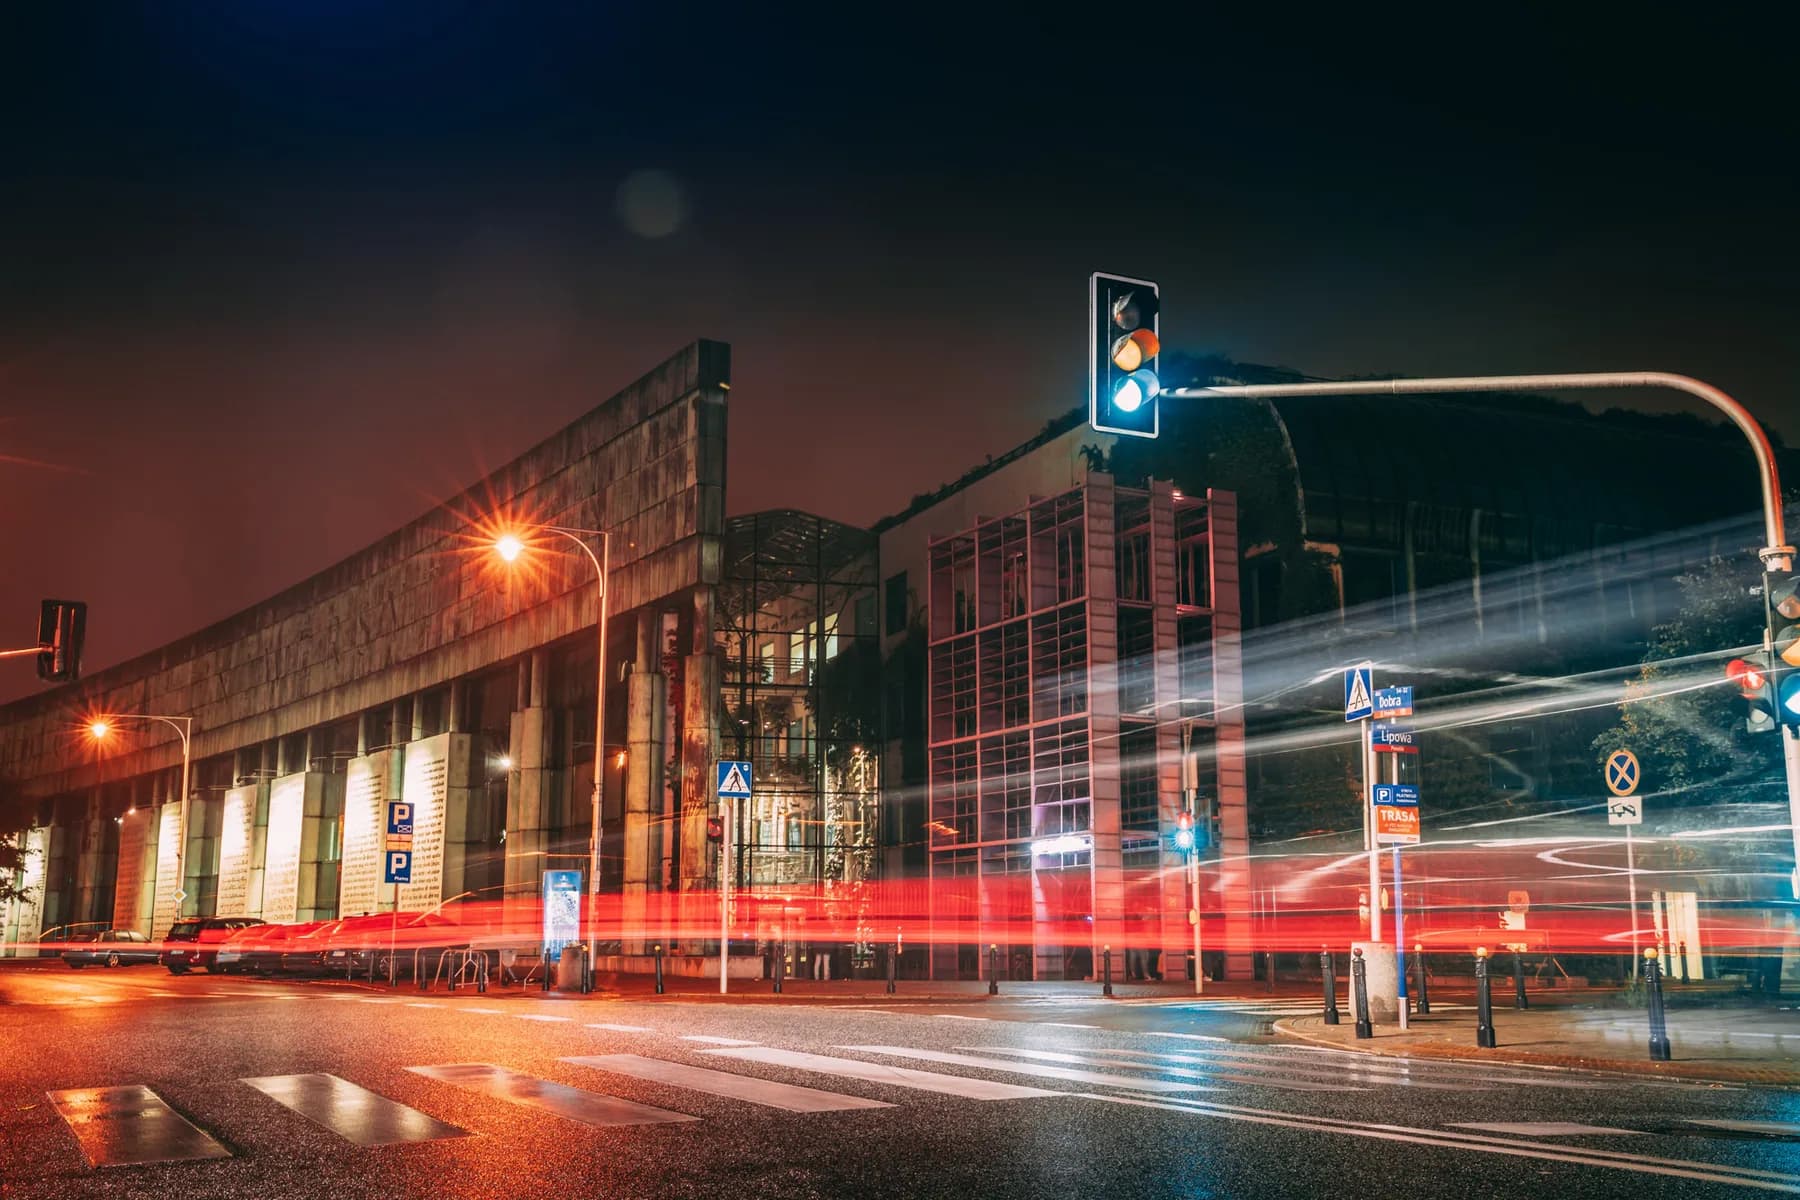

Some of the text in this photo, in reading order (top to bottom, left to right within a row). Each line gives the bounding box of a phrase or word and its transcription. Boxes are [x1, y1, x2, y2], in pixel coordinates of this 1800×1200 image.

[1379, 695, 1402, 708] Dobra
[1381, 729, 1412, 744] Lipowa
[1379, 790, 1388, 801] P
[393, 804, 410, 825] P
[1380, 809, 1417, 822] TRASA
[391, 853, 407, 874] P
